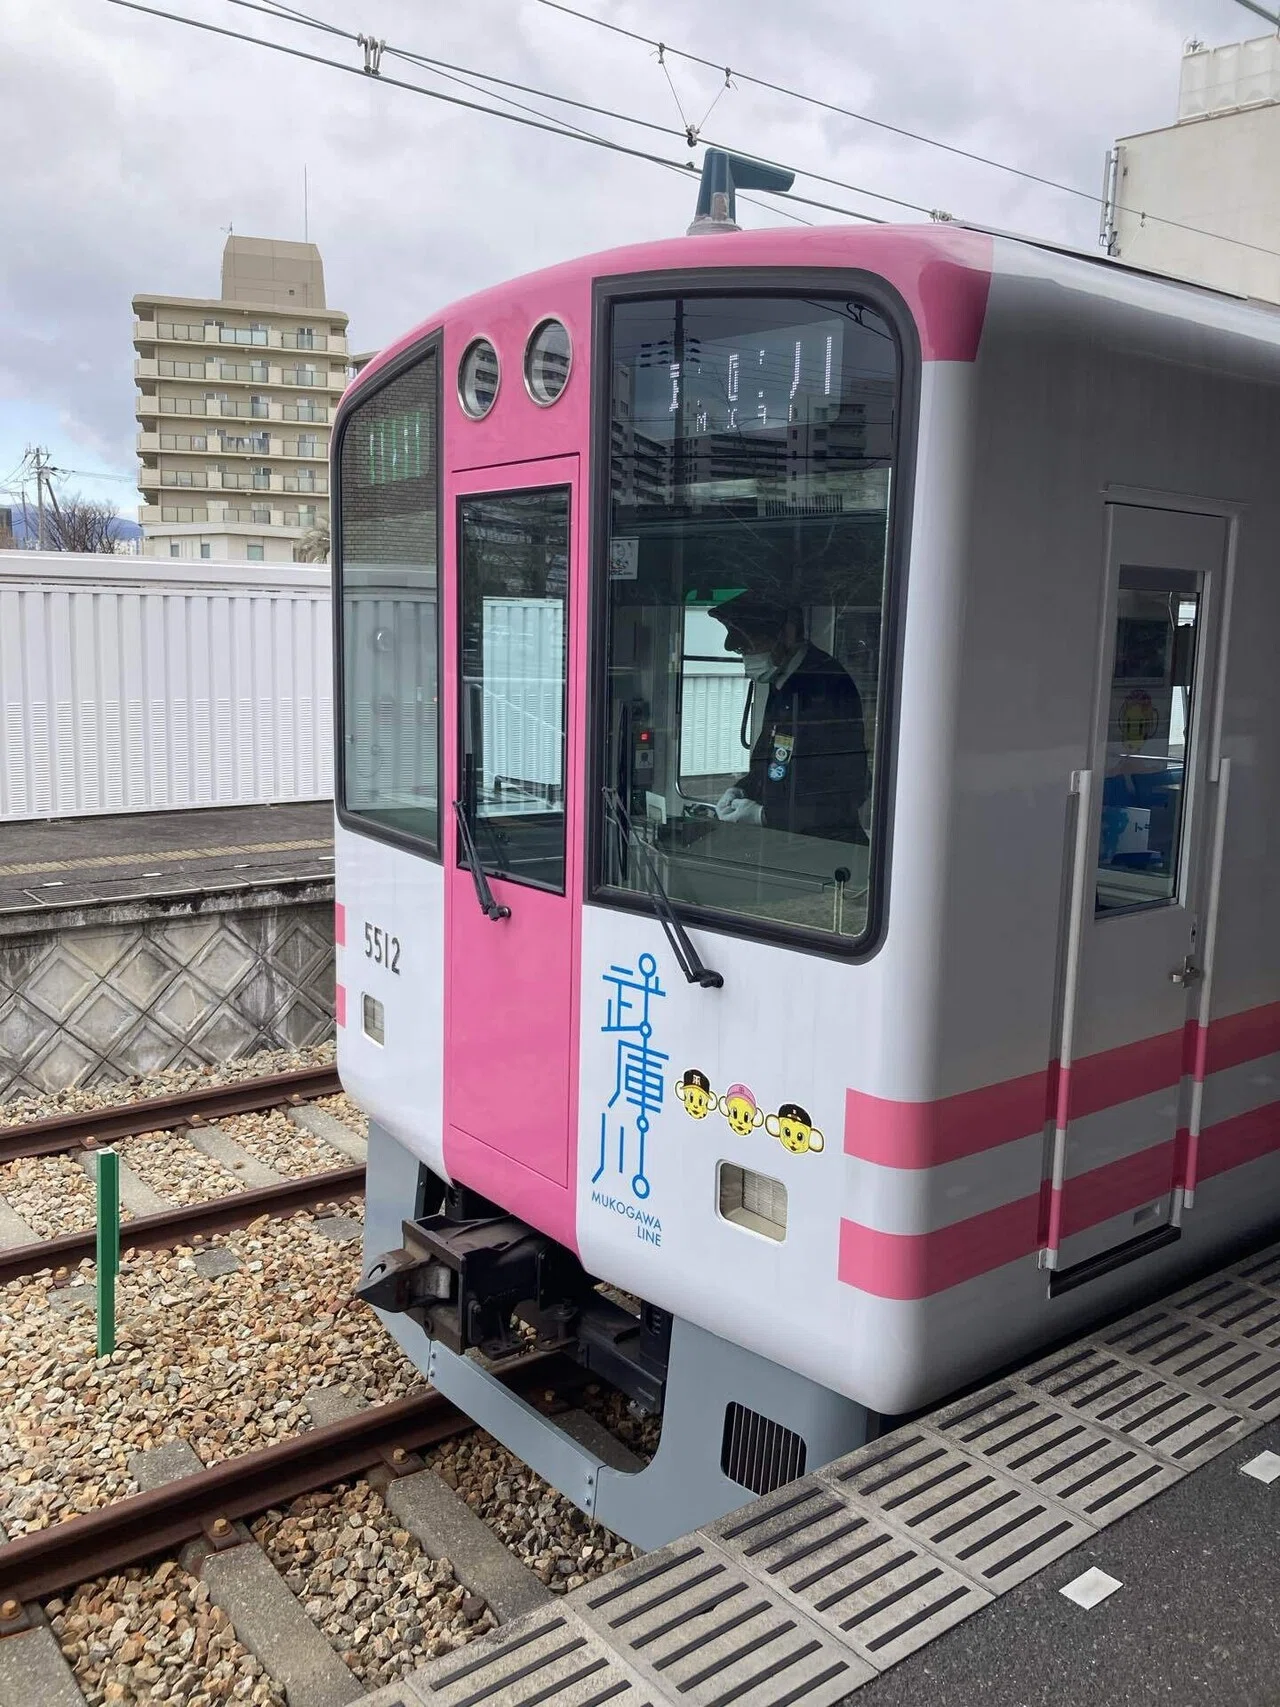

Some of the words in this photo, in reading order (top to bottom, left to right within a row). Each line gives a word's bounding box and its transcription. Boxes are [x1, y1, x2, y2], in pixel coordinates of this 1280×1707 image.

[365, 922, 400, 975] 5512
[592, 952, 669, 1199] 武庫川
[591, 1190, 662, 1232] MUKOGAWA
[637, 1225, 662, 1247] LINE
